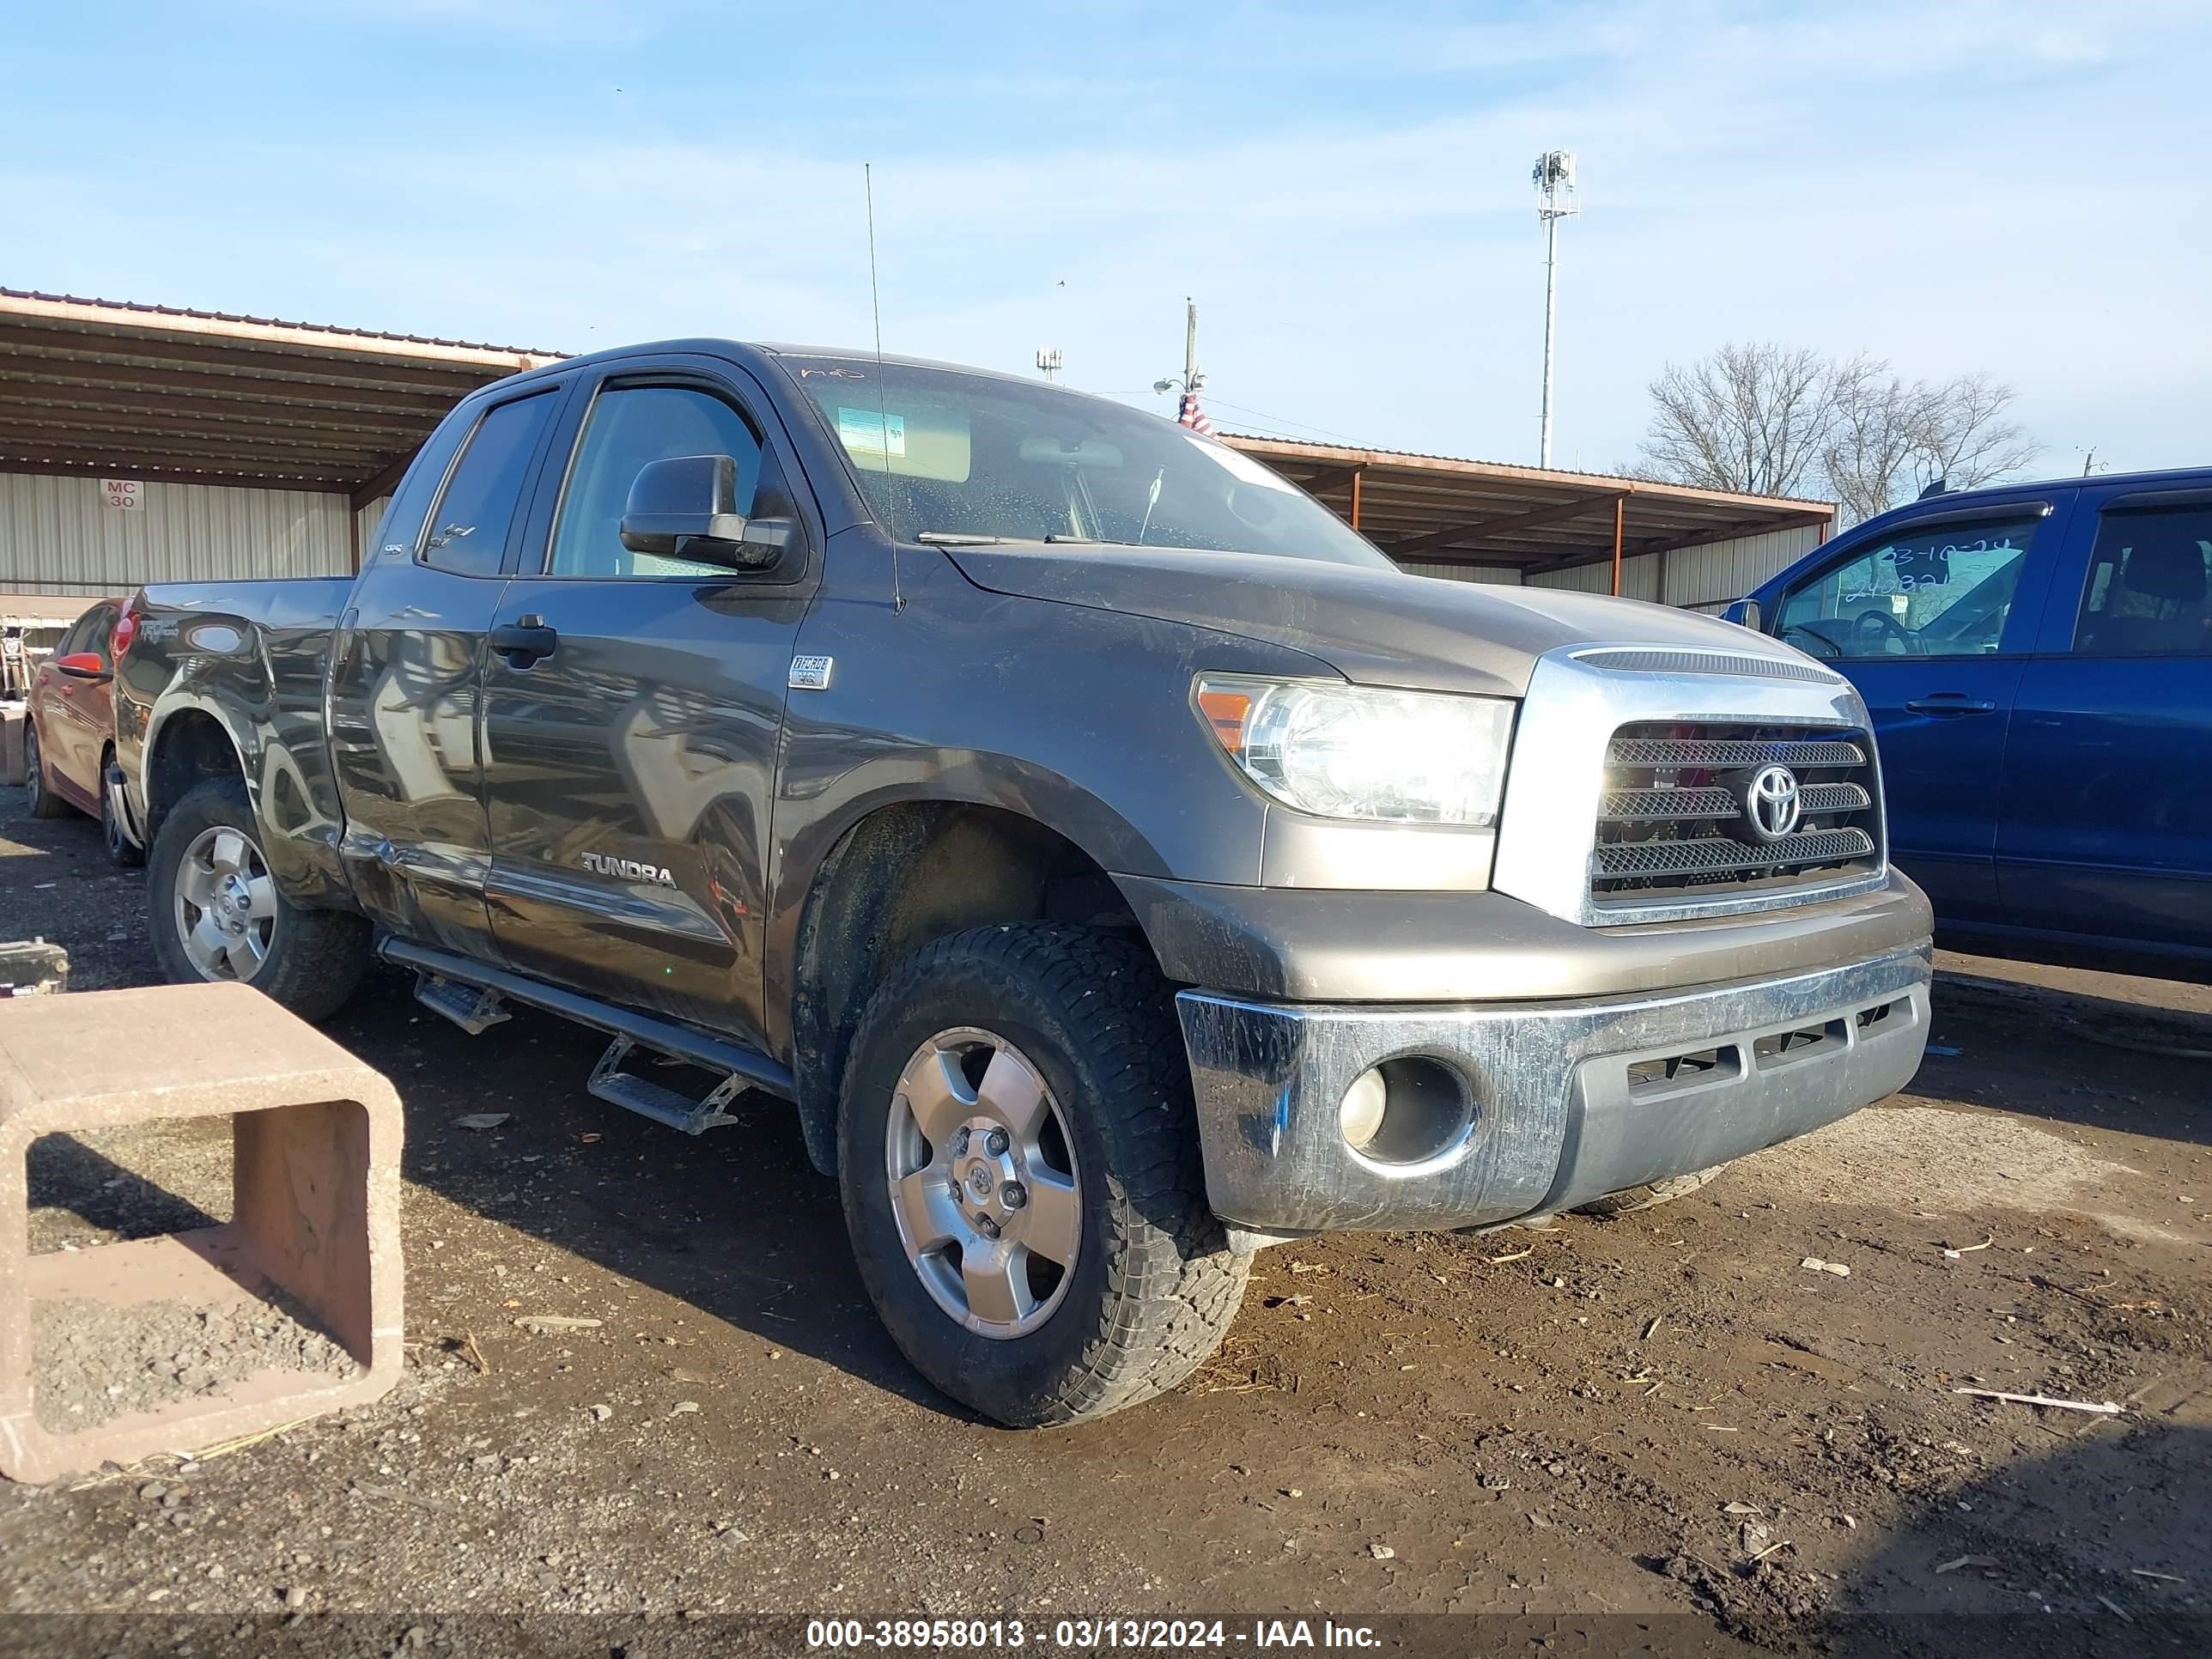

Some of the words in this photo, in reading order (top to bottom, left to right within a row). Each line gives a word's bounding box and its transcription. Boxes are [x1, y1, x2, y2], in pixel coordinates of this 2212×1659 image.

[107, 482, 137, 494] MC
[111, 495, 135, 507] 30
[580, 851, 678, 890] TUNDRA
